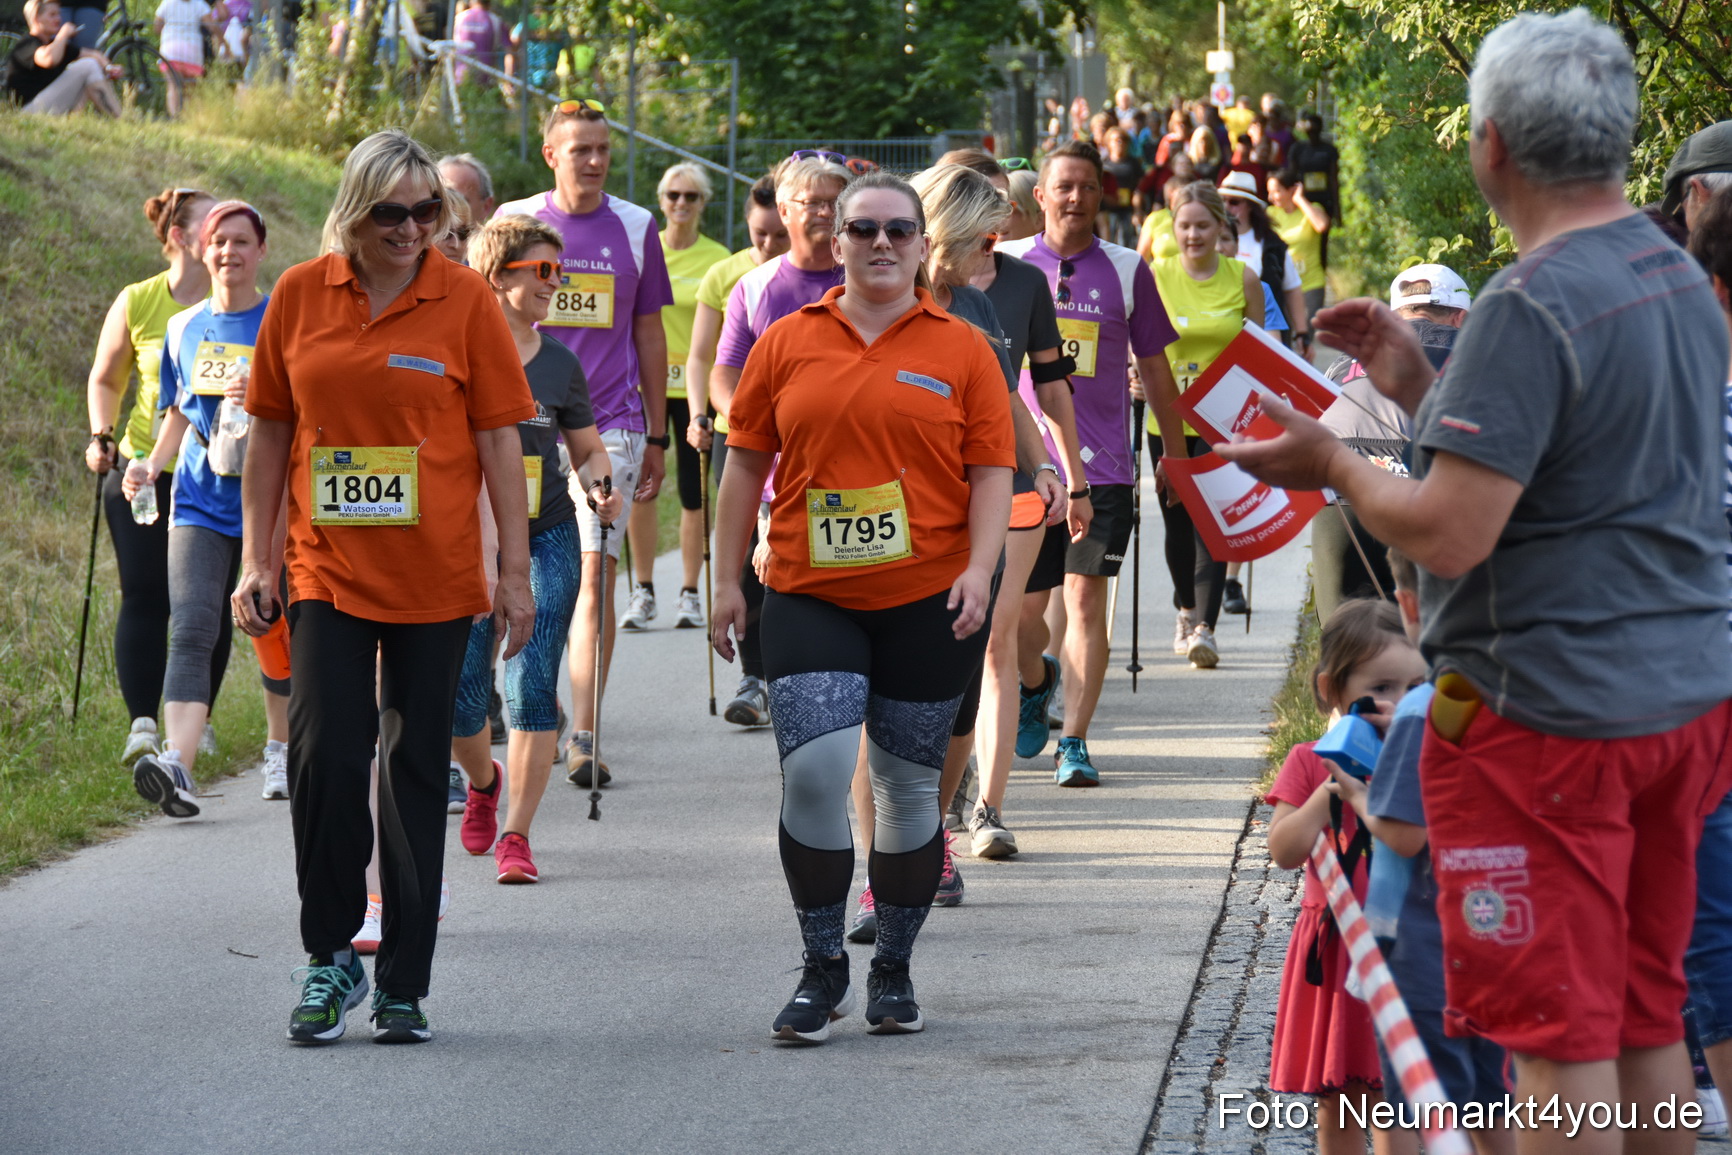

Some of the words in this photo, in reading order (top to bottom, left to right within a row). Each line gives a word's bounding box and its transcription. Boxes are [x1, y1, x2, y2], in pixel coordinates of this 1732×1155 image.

[563, 258, 589, 268] SIND
[590, 260, 615, 271] LILA.
[556, 292, 597, 312] 884
[1077, 303, 1104, 315] LILA.
[405, 359, 438, 371] WATSON
[913, 376, 945, 391] DEIERLER
[1240, 403, 1257, 429] DEHN
[325, 462, 368, 471] firmenlauf
[324, 475, 404, 504] 1804
[343, 504, 377, 513] Watson
[378, 504, 402, 514] Sonja
[820, 504, 857, 513] firmenlauf
[1235, 492, 1260, 517] DEHN
[819, 512, 896, 545] 1795
[1226, 534, 1257, 549] DEHN
[1257, 510, 1297, 542] protects.
[834, 546, 865, 554] Deierler
[867, 543, 885, 552] Lisa
[868, 550, 886, 558] GmbH
[1104, 553, 1124, 562] adida
[1487, 871, 1535, 946] 5
